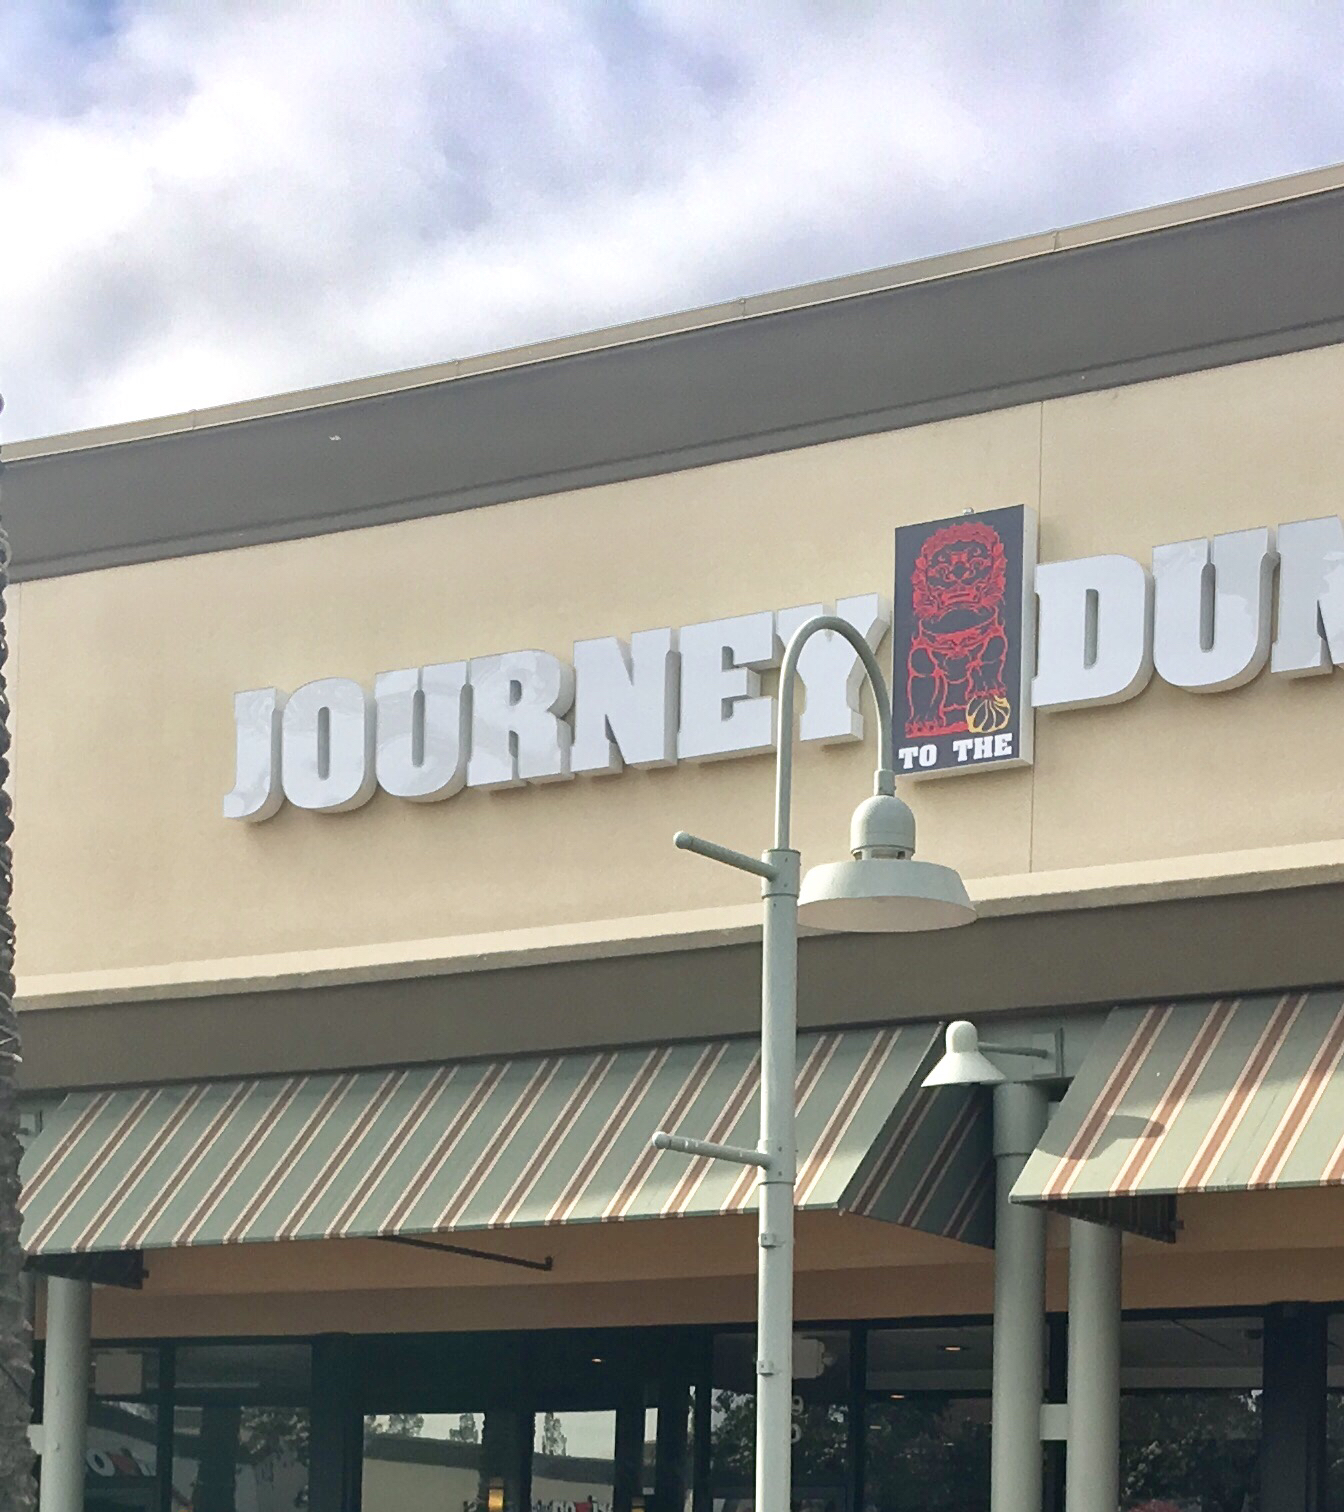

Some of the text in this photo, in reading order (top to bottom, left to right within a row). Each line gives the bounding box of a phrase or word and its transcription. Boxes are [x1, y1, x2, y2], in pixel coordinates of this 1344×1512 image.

[222, 592, 892, 824] JOURNEY
[898, 732, 1013, 770] TO THE
